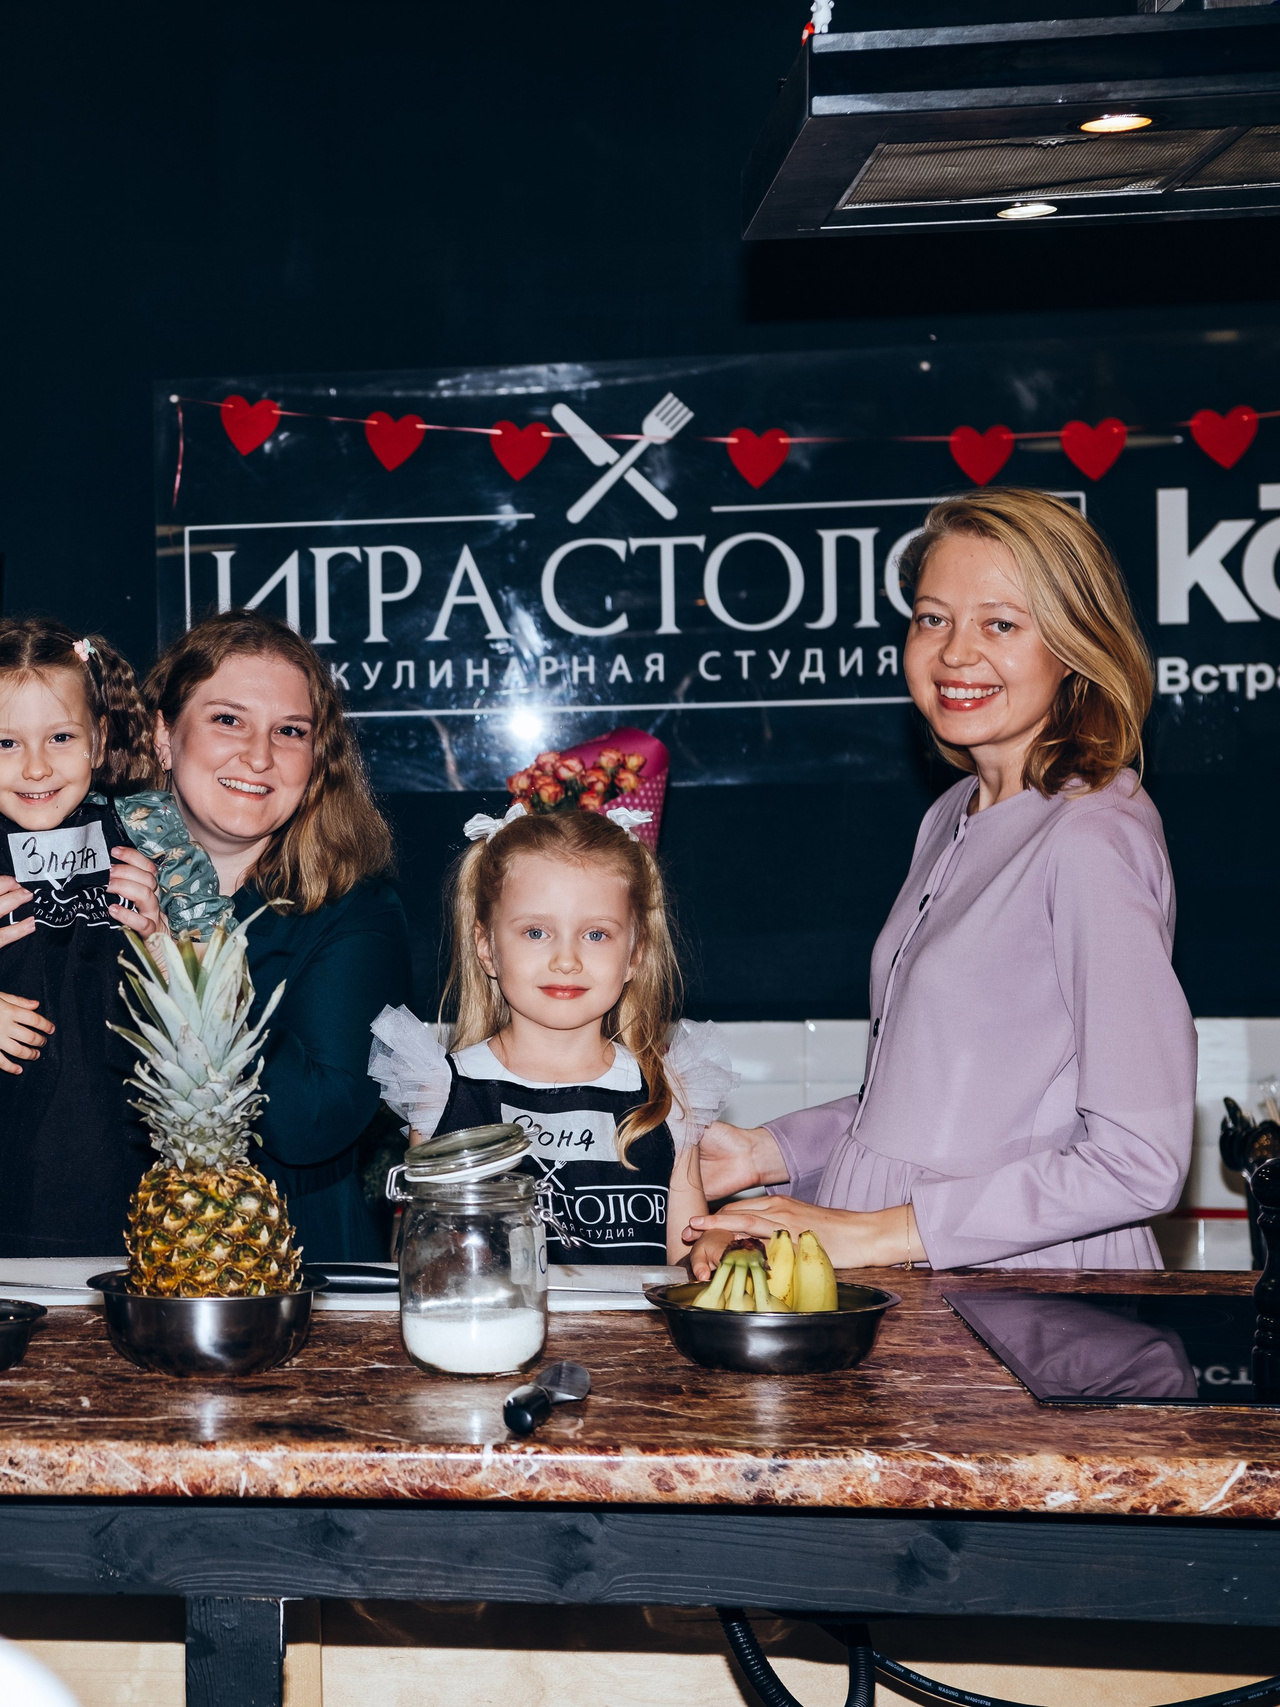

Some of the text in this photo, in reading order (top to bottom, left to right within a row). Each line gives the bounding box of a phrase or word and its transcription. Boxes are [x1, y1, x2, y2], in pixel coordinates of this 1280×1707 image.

[211, 526, 924, 645] ИГРА СТОЛ
[330, 644, 898, 691] КУЛИНАРНАЯ СТУДИЯ
[1157, 656, 1280, 700] Встр
